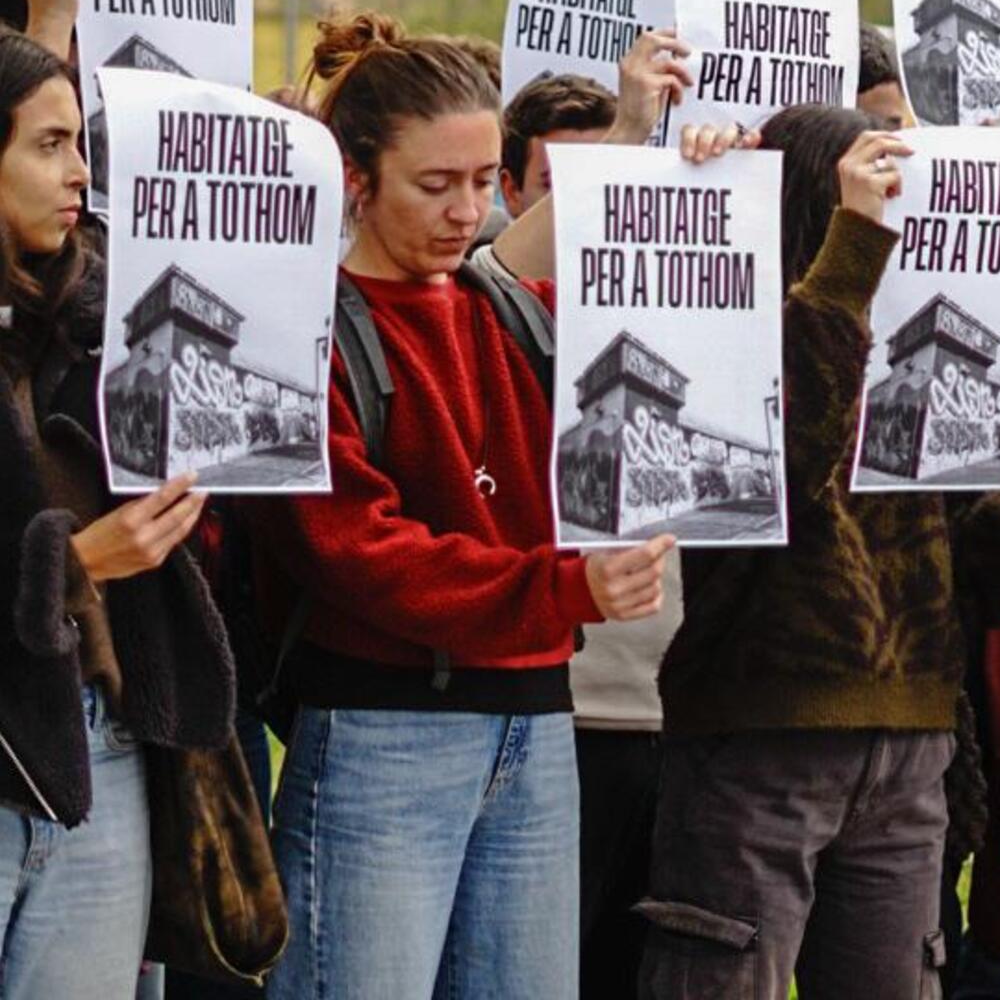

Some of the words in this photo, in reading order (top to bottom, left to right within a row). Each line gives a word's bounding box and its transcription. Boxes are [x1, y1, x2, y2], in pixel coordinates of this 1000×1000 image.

[515, 3, 555, 53] PER
[556, 11, 572, 56] A
[724, 0, 831, 60] HABITATGE
[697, 52, 744, 104] PER
[744, 56, 762, 106] A
[769, 57, 844, 108] TOTHOM
[157, 110, 293, 179] HABITATGE
[132, 175, 177, 240] PER
[180, 179, 199, 241] A
[206, 180, 317, 245] TOTHOM
[604, 184, 732, 247] HABITATGE
[899, 216, 948, 272] PER
[949, 218, 969, 273] A
[581, 247, 625, 307] PER
[630, 249, 648, 308] A
[654, 250, 755, 310] TOTHOM
